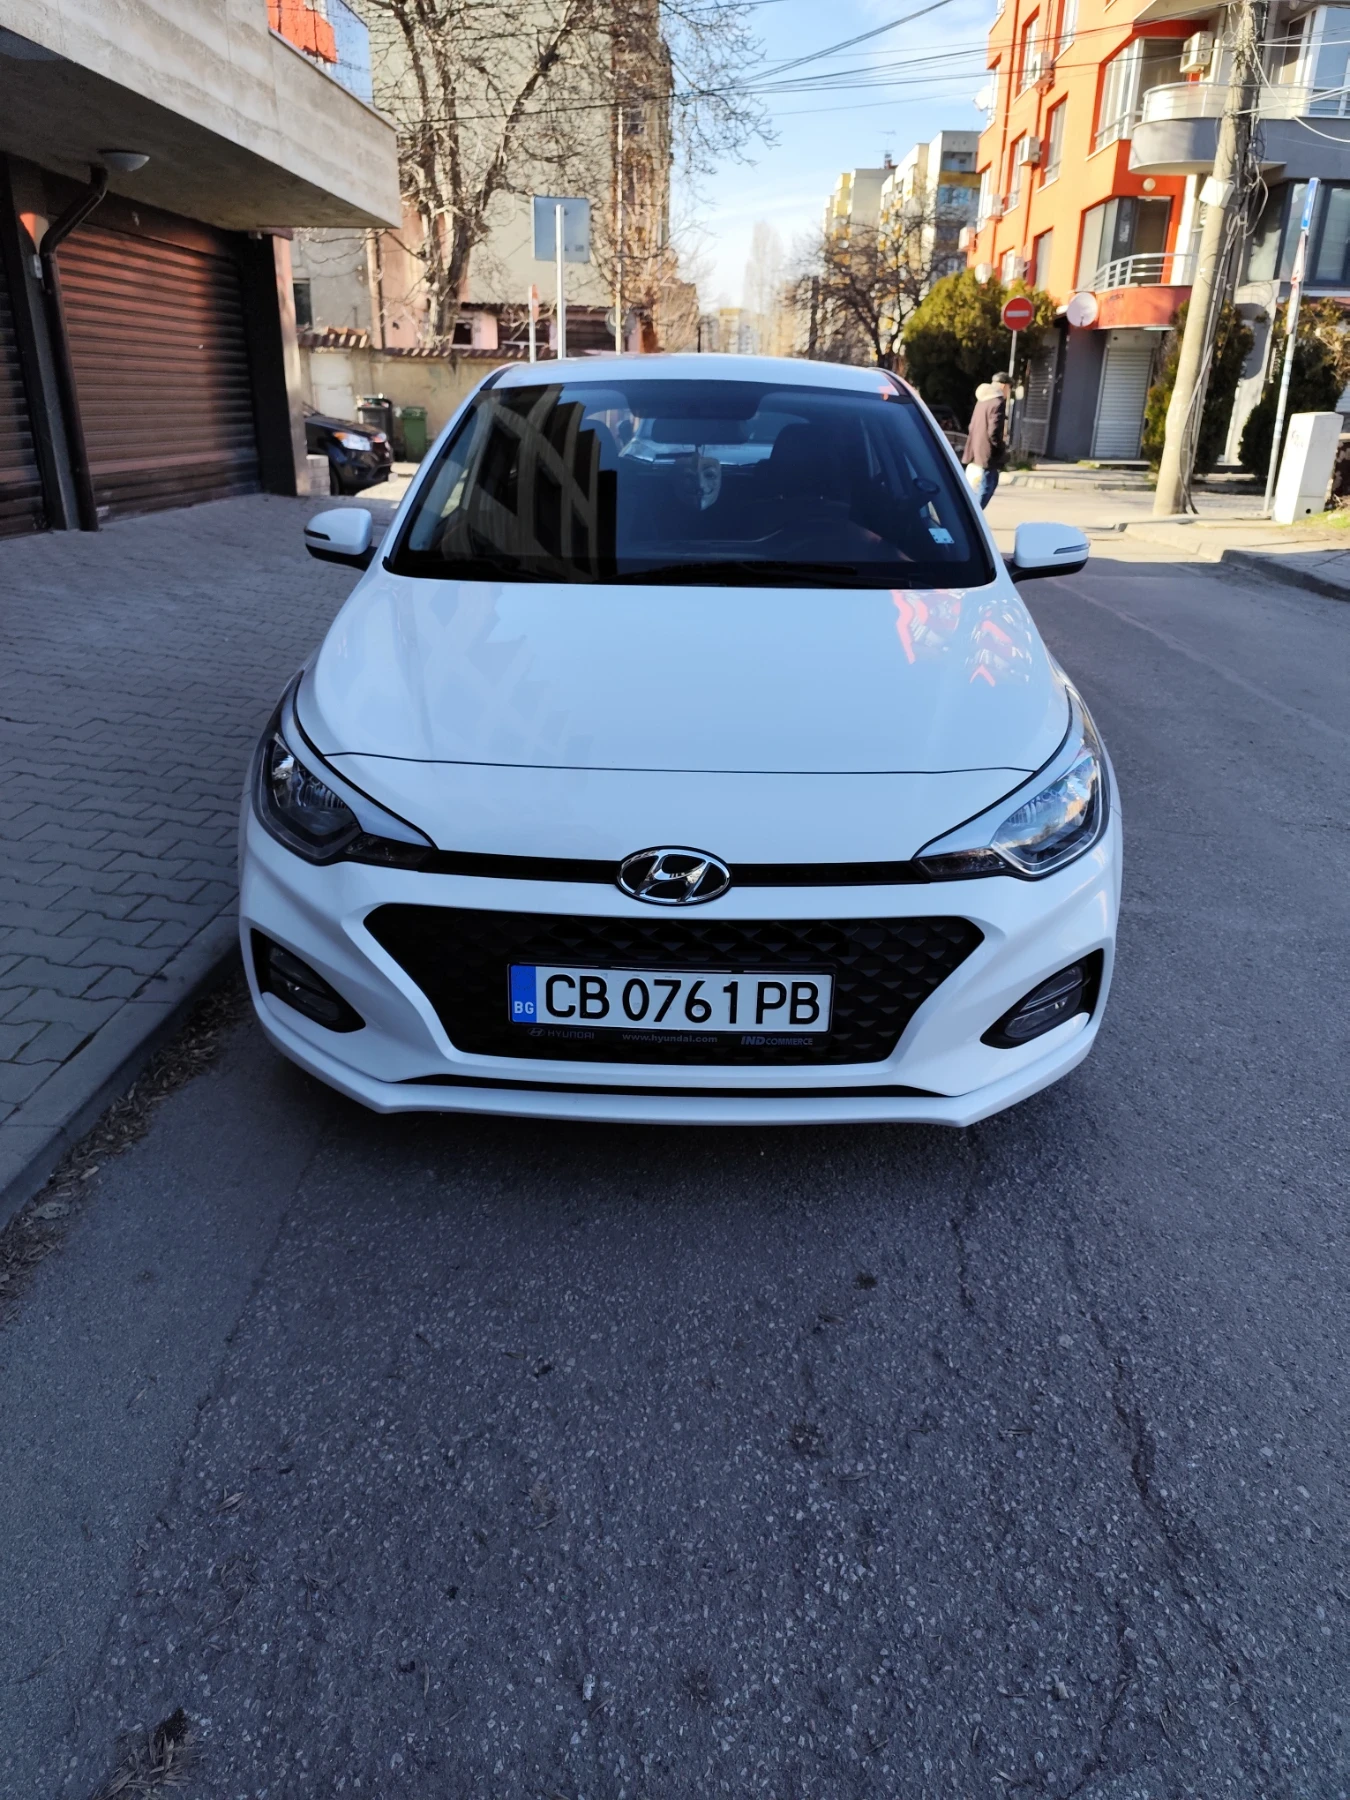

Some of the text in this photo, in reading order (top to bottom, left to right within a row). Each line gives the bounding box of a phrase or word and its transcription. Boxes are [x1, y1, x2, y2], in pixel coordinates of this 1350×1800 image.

[545, 974, 820, 1025] CB 0761 PB
[514, 1001, 534, 1014] BG
[547, 1030, 595, 1039] HYUNDAI
[622, 1033, 718, 1044] www.hyundai.com
